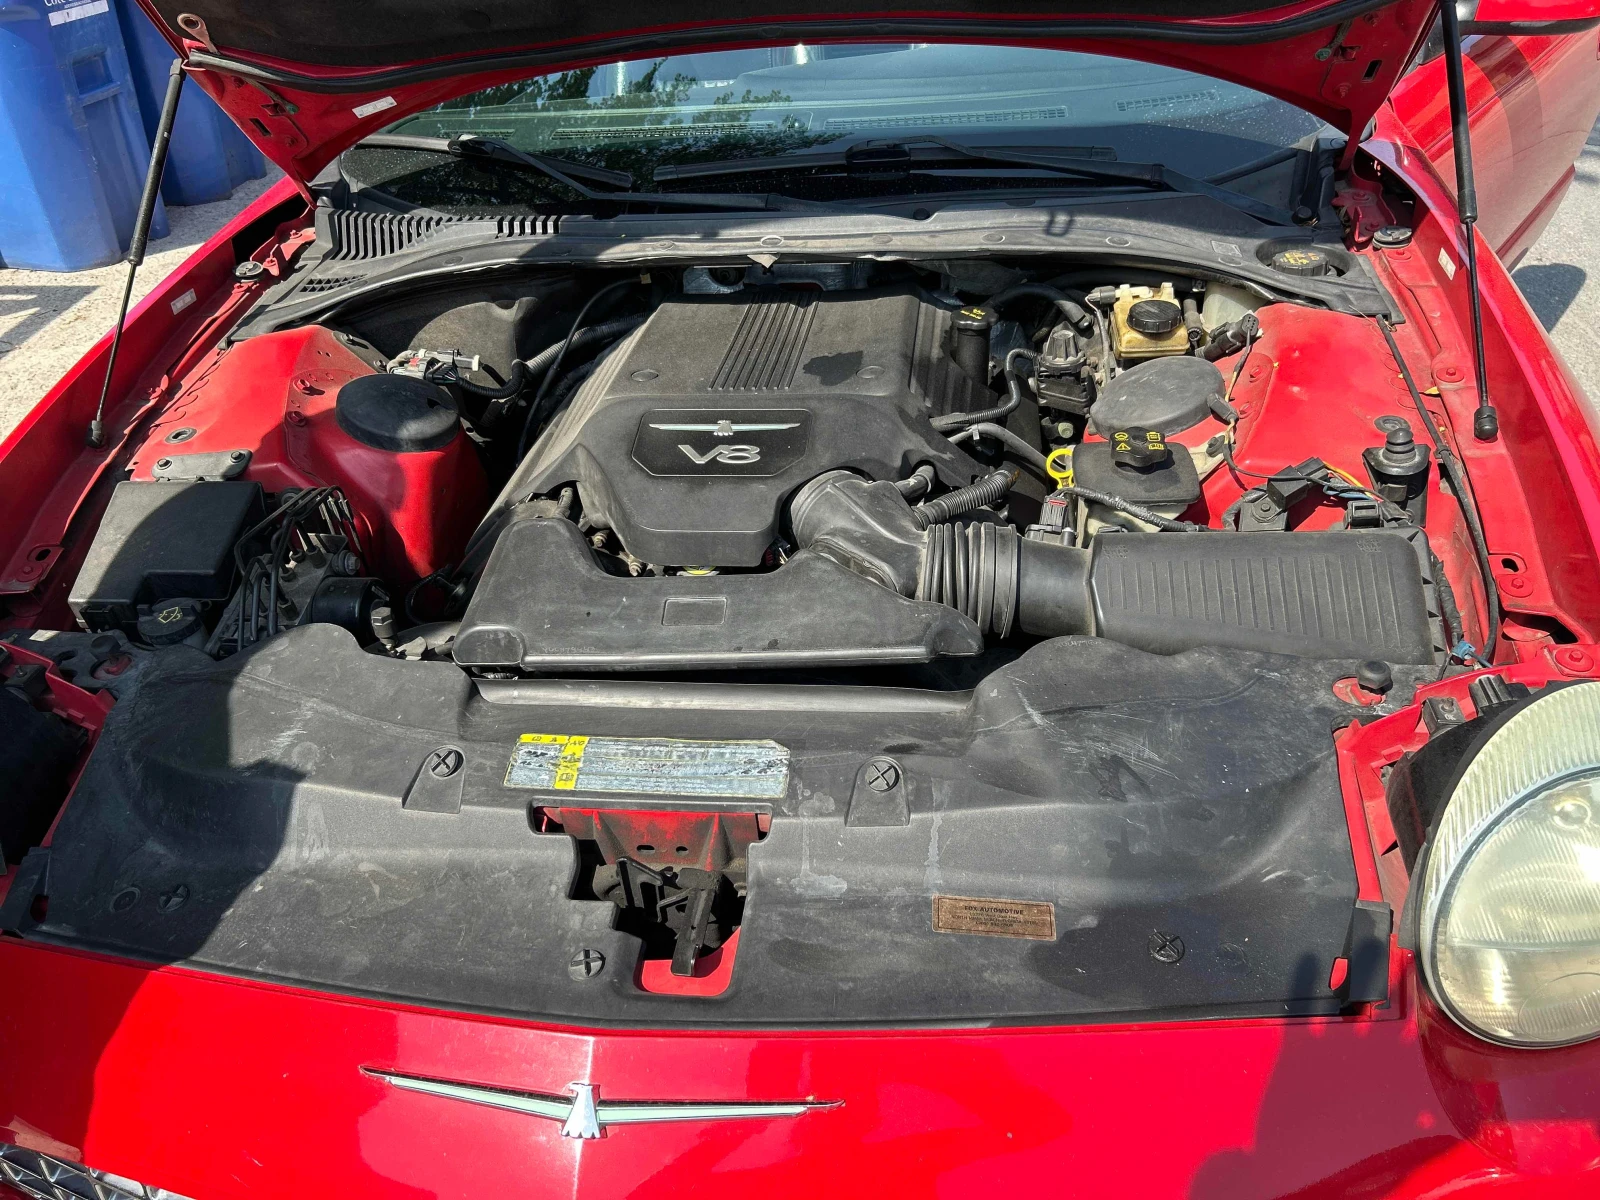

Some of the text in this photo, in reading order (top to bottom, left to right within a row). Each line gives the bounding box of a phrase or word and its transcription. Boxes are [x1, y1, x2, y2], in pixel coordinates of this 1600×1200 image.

[677, 444, 761, 464] V8
[964, 904, 978, 912] FOX
[979, 906, 1024, 915] AUTOMOTIVE
